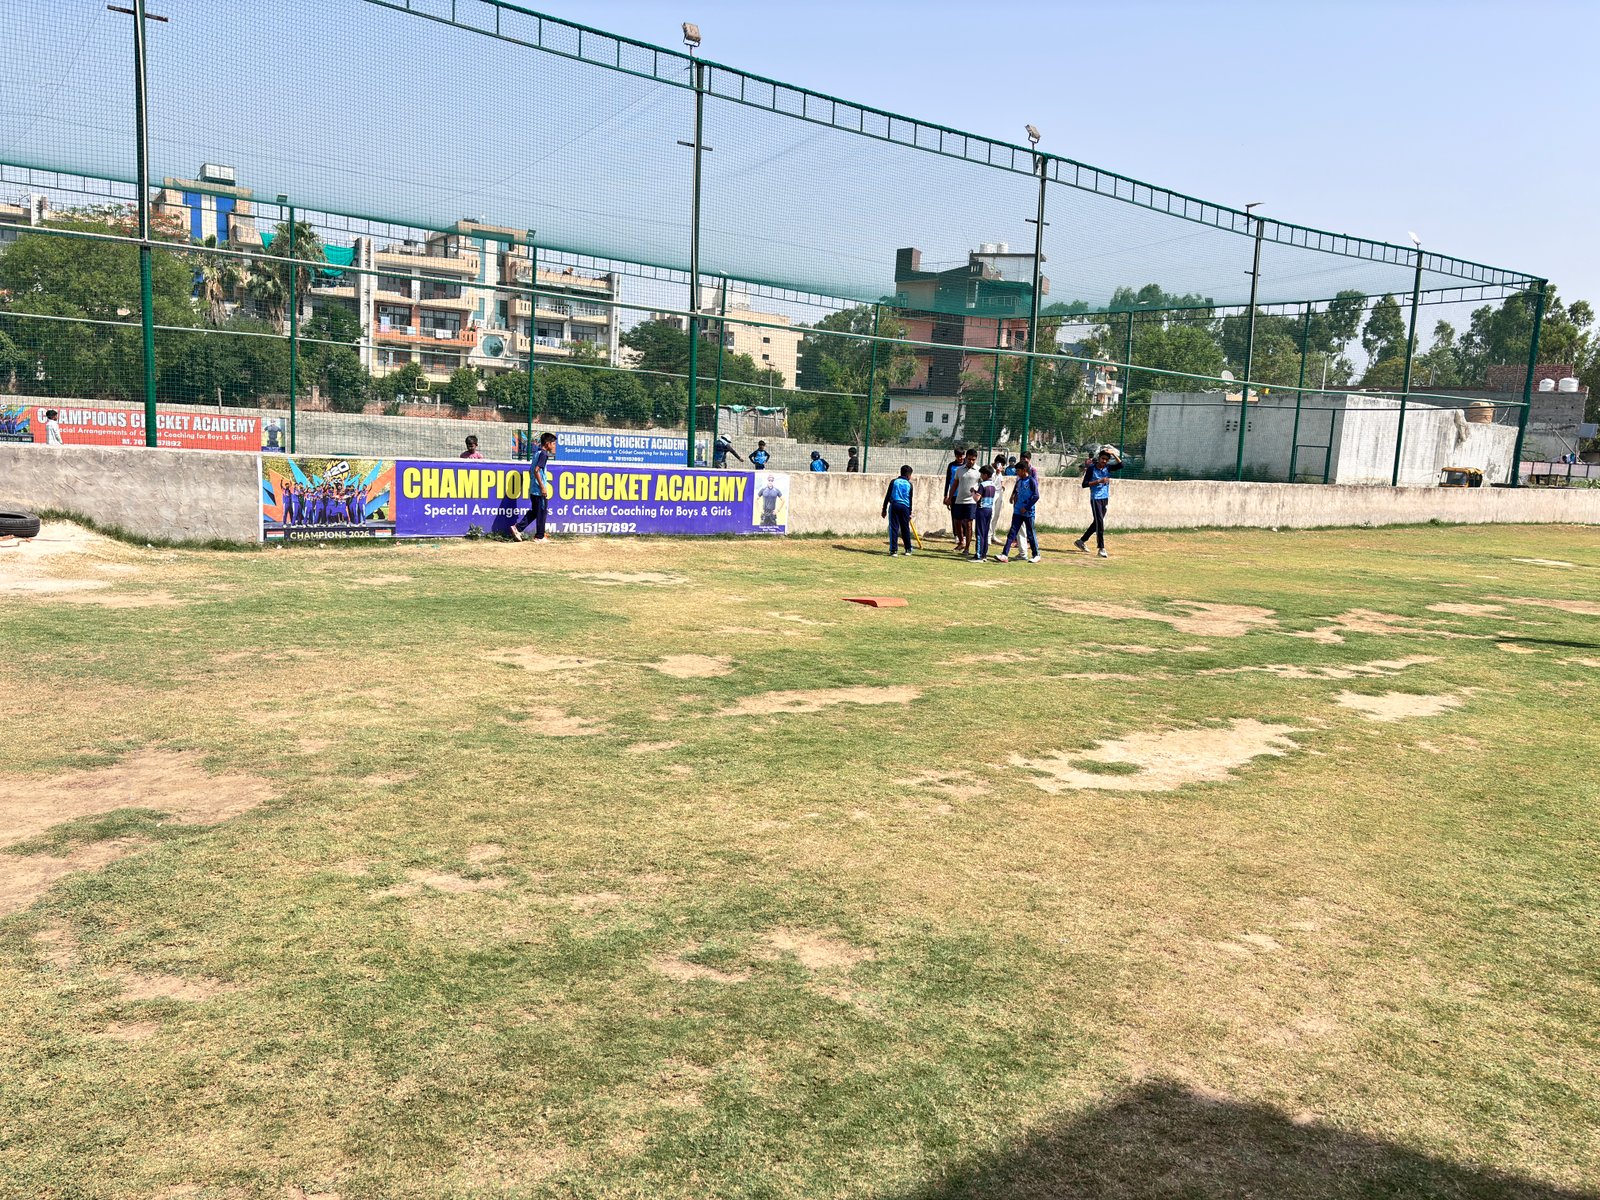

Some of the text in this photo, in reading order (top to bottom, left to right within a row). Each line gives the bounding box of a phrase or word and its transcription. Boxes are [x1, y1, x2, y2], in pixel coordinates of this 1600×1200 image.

[37, 408, 256, 433] CAMPIONS CCKET ACADEMY
[78, 427, 127, 436] Arrangements
[164, 431, 195, 440] Coaching
[207, 434, 223, 442] Boys
[231, 434, 247, 442] Girls
[557, 433, 612, 448] CHAMPIONS
[613, 436, 650, 449] CRICKET
[559, 471, 651, 501] CRICKET
[655, 475, 748, 502] ACADEMY
[424, 503, 468, 518] Special
[557, 505, 569, 516] of
[572, 505, 607, 516] Cricket
[610, 505, 657, 519] Coaching
[660, 505, 673, 517] for
[676, 505, 699, 519] Boys
[701, 506, 708, 517] &
[711, 505, 732, 517] Girls
[290, 530, 370, 540] CHAMPIONS 2026
[545, 522, 636, 533] M. 7015157892
